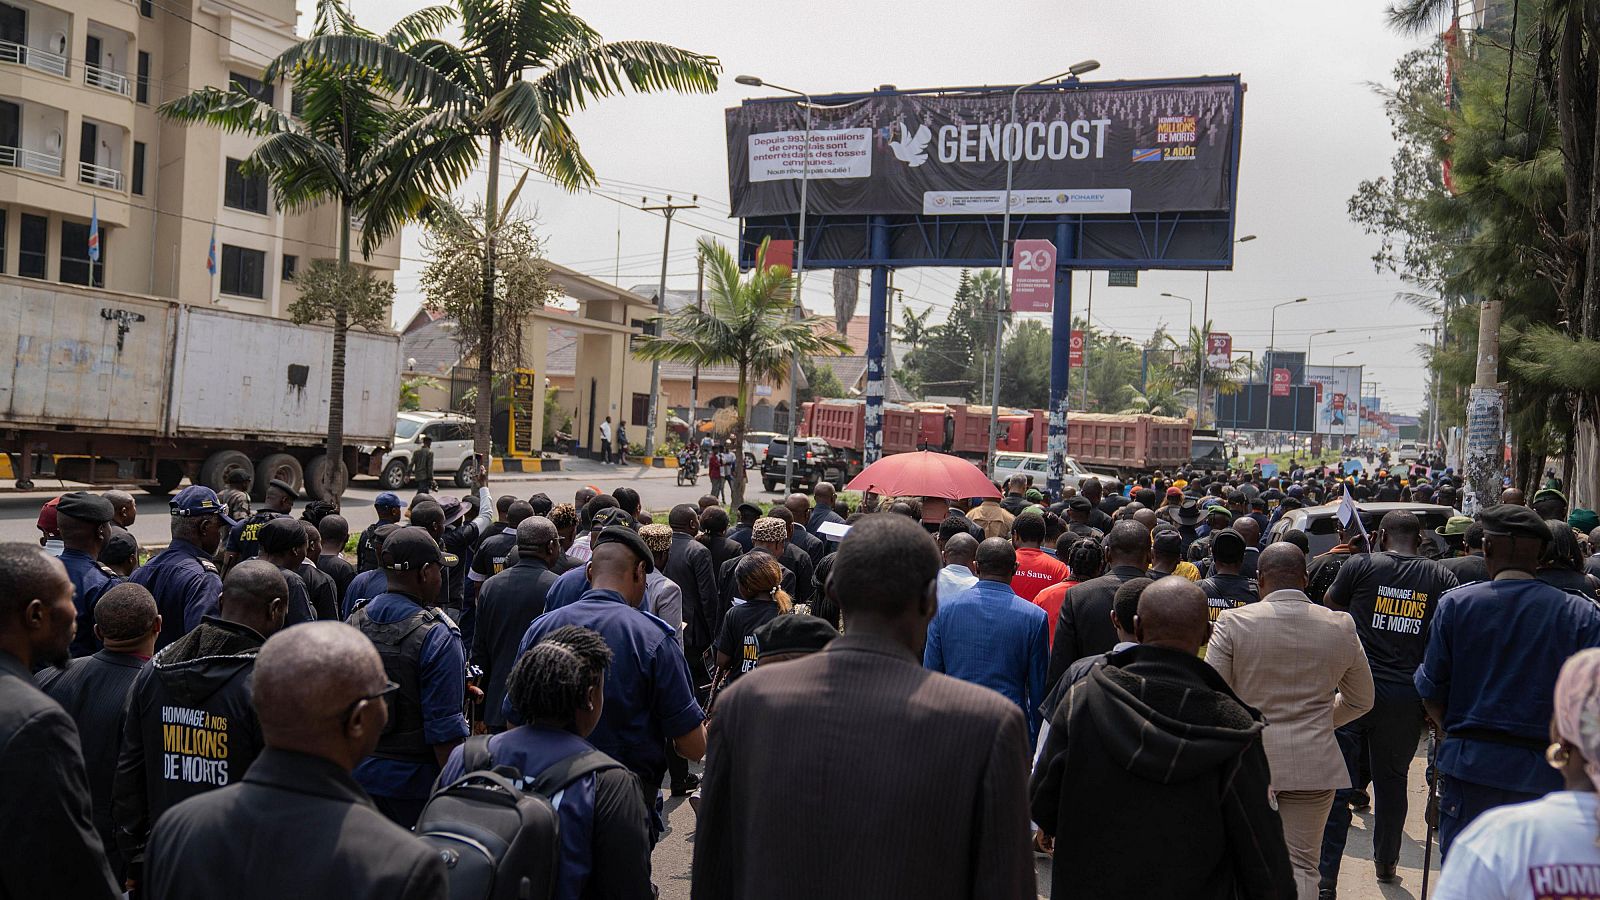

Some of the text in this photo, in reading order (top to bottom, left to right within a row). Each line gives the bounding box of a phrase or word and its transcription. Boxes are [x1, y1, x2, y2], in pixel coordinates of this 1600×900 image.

[1158, 122, 1195, 132] MILLIONS
[754, 136, 785, 146] Depuis
[827, 133, 865, 141] millions
[937, 119, 1111, 163] GENOCOST
[1157, 132, 1195, 142] DE MORTS
[826, 142, 847, 150] sont
[1164, 145, 1196, 157] 2 AOÛT
[753, 152, 790, 161] enterrés
[815, 150, 833, 158] des
[834, 149, 866, 157] fosses
[1019, 250, 1051, 271] 20
[1275, 373, 1289, 382] 20
[1026, 569, 1052, 581] Sauve
[1378, 585, 1412, 600] HOMMAGE
[1416, 592, 1428, 602] NOS
[1374, 595, 1426, 619] MILLIONS
[1371, 613, 1422, 635] DE MORTS
[162, 705, 227, 731] HOMMAGE À NOS
[163, 724, 228, 759] MILLIONS
[164, 753, 229, 786] DE MORTS
[1534, 865, 1600, 896] HOM
